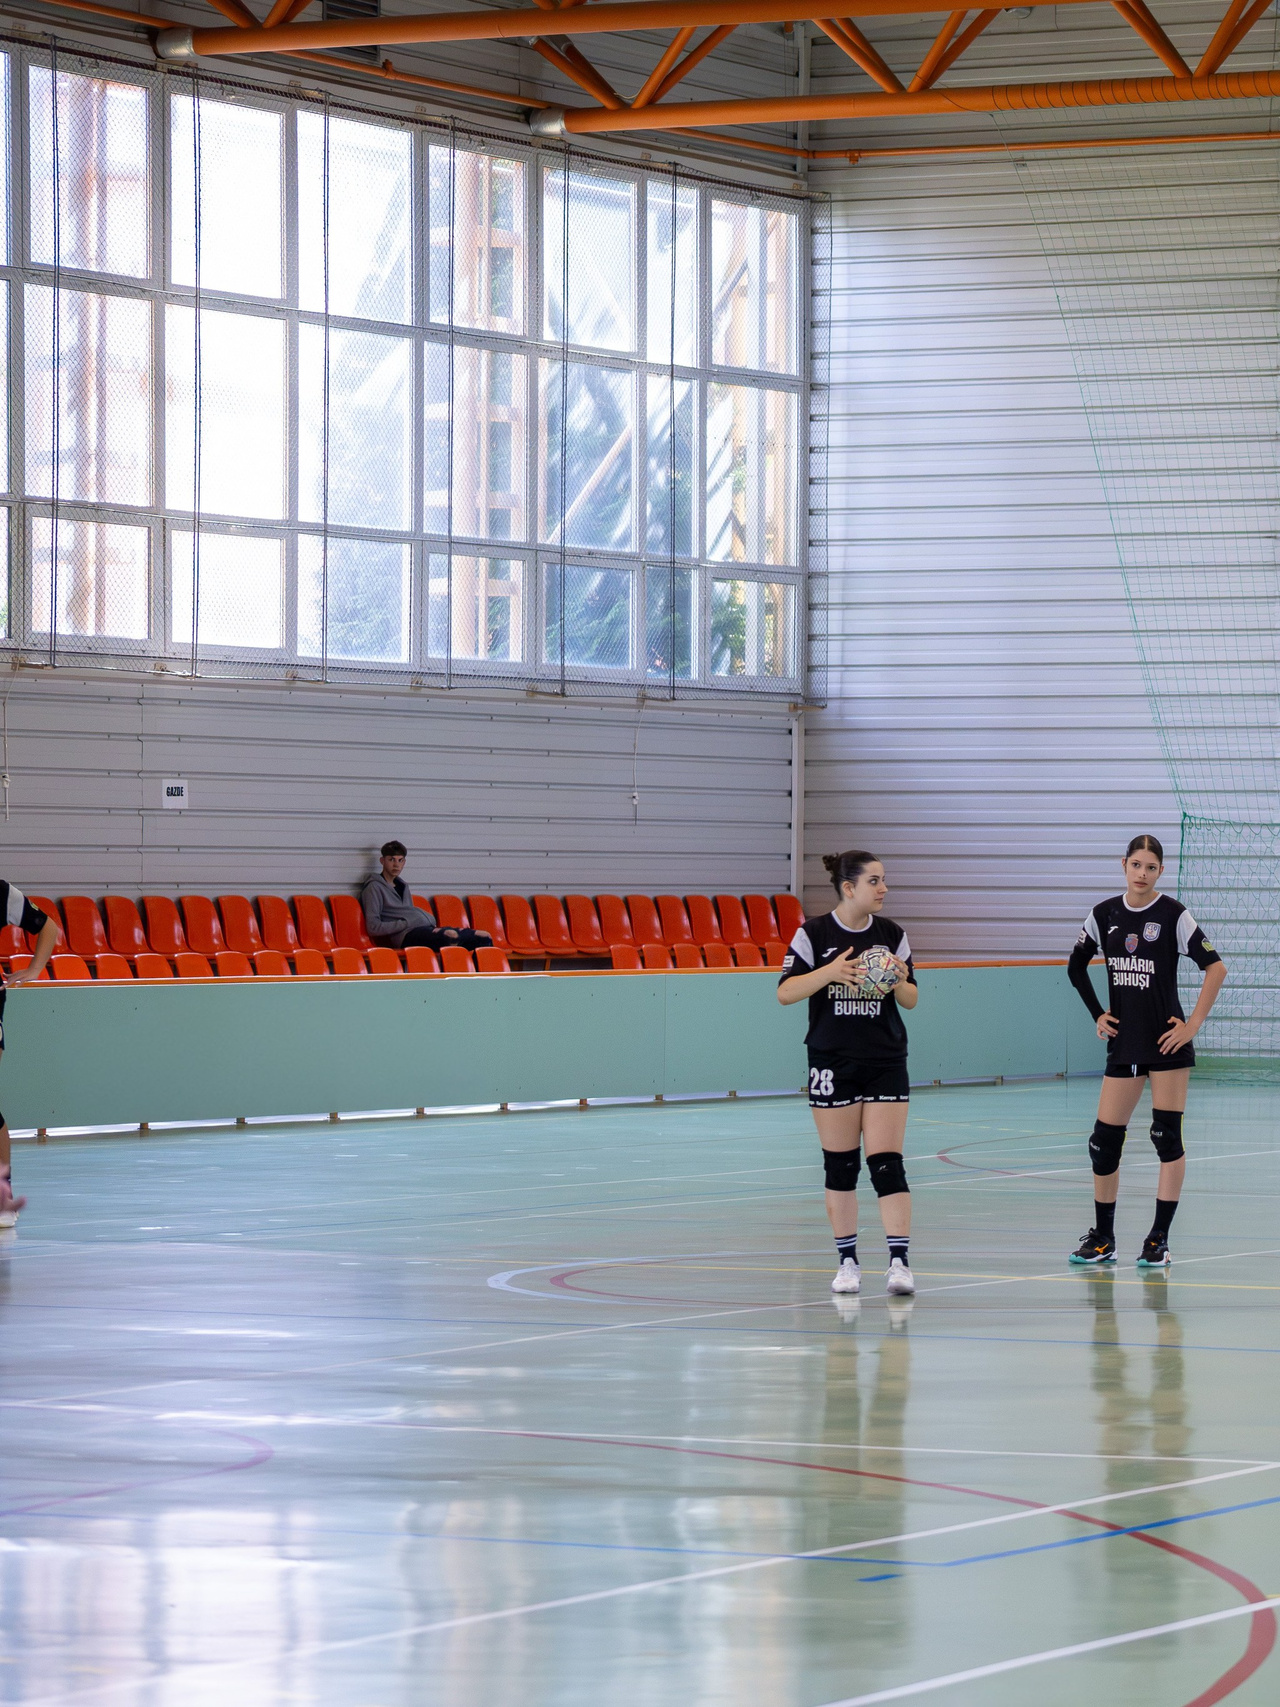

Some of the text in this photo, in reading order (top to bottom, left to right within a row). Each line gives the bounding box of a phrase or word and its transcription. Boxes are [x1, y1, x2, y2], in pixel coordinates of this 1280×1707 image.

[166, 786, 184, 797] GAZDE
[1108, 955, 1155, 974] PRIMĂRIA
[1113, 972, 1150, 990] BUHUȘI
[834, 1001, 881, 1018] BUHUȘI
[810, 1067, 834, 1096] 28
